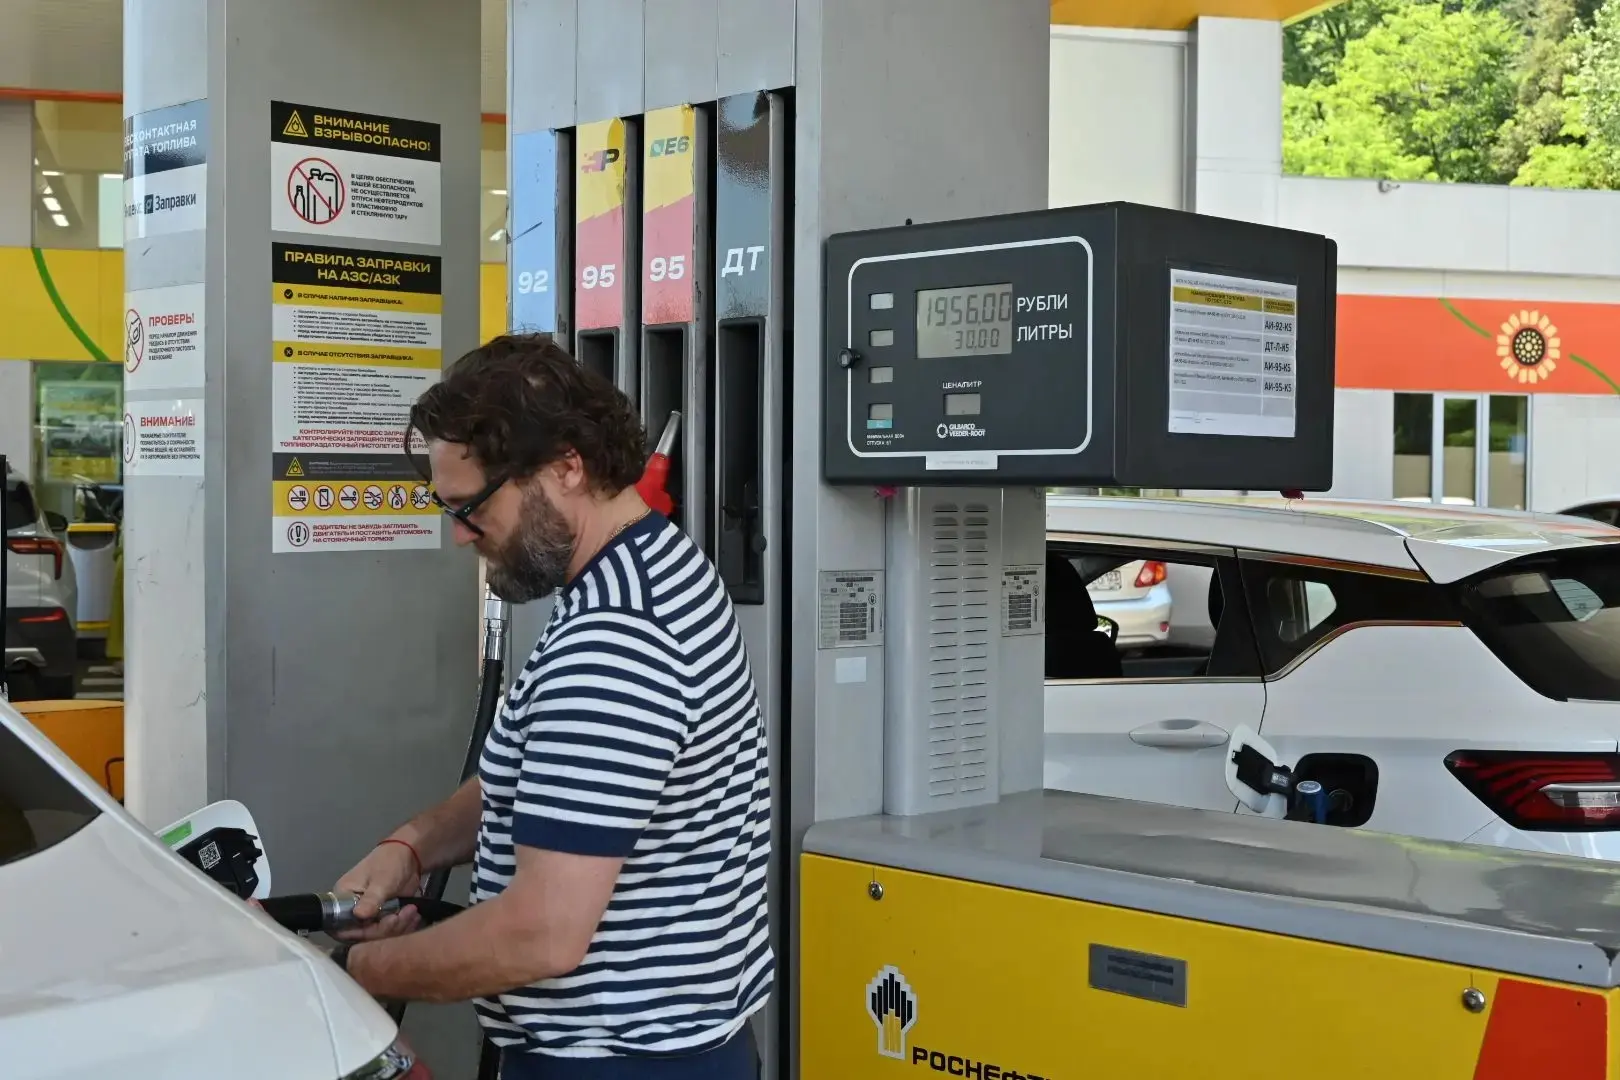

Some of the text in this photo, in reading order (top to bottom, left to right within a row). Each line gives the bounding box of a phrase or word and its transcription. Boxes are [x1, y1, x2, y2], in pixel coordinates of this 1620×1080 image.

[314, 114, 390, 133] ВНИМАНИЕ
[151, 135, 197, 154] ТОПЛИВА
[314, 127, 431, 151] ВЗРЫВООПАСНО!
[375, 176, 415, 186] ОБЕСПЕЧЕНИЯ
[155, 193, 197, 211] Заправки
[359, 189, 410, 199] ОСУЩЕСТВЛЯЕТСЯ
[374, 198, 424, 208] НЕФТЕПРОДУКТОВ
[356, 203, 398, 212] ПЛАСТИКОВУЮ
[356, 210, 394, 219] СТЕКЛЯННУЮ
[284, 251, 431, 273] ПРАВИЛА ЗАПРАВКИ
[649, 255, 685, 282] 95
[721, 245, 764, 278] ДТ
[317, 268, 401, 285] НА АЗС/АЗК
[518, 270, 549, 294] 92
[581, 264, 616, 289] 95
[927, 291, 1011, 327] 1956.00
[1017, 294, 1068, 312] РУБЛИ
[149, 312, 195, 328] ПРОВЕРЬ!
[1264, 320, 1292, 332] АИ-92-К5
[955, 328, 999, 350] 30.00
[1016, 323, 1073, 342] ЛИТРЫ
[1264, 361, 1292, 373] АИ-95-К5
[1264, 381, 1292, 393] АИ-95-К5
[140, 414, 195, 427] ВНИМАНИЕ!
[299, 428, 354, 436] КОНТРОЛИРУЙТЕ
[949, 429, 986, 437] VEEDER-ROOT
[913, 1046, 1053, 1080] РОСНЕФ
